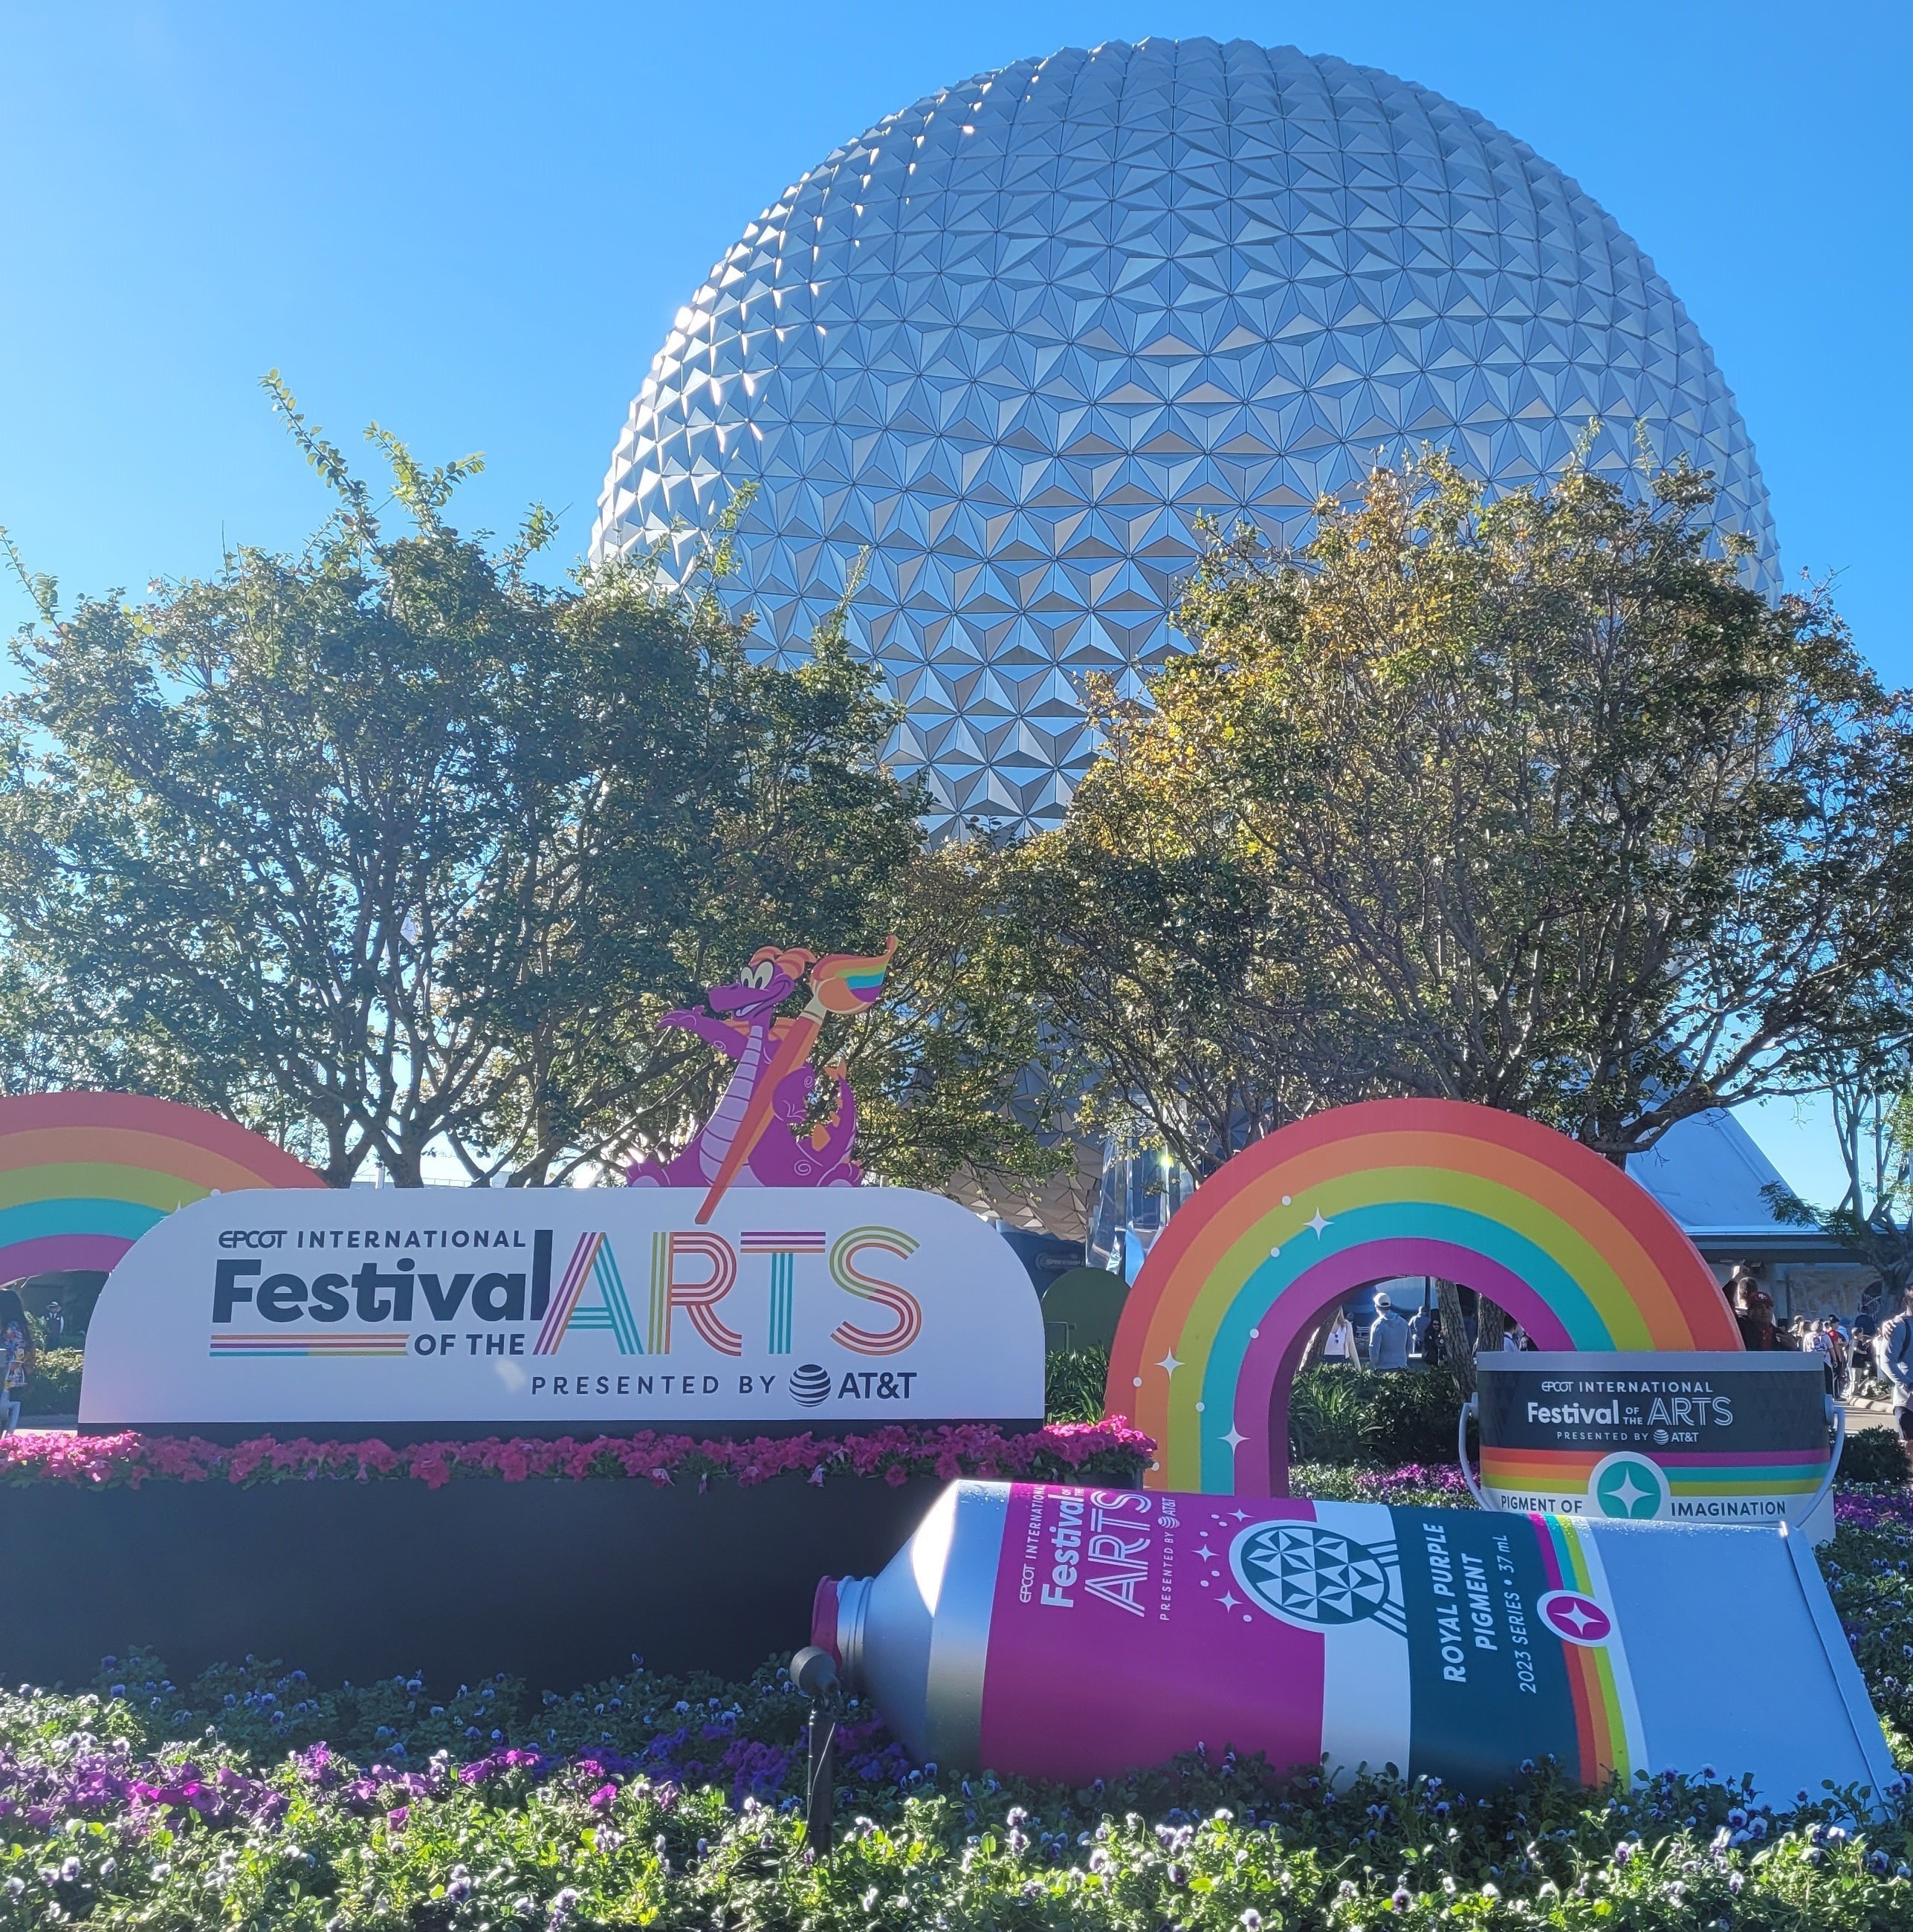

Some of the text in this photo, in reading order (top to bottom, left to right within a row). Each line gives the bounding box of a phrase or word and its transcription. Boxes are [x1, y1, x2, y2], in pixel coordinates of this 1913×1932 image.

[218, 1230, 526, 1248] EPCOT INTERNATIONAL
[212, 1230, 553, 1323] Festival
[532, 1225, 922, 1357] ARTS
[414, 1333, 525, 1356] OF THE
[531, 1372, 918, 1399] PRESENTED BY AT&T
[1541, 1381, 1713, 1393] EPCOT INTERNATIONAL
[1527, 1396, 1733, 1427] Festival OF THE ARTS
[1557, 1431, 1700, 1443] PRESENTED BY AT&T
[1501, 1495, 1785, 1517] PIGMENT OF IMAGINATION
[1040, 1494, 1084, 1608] Festival
[1084, 1491, 1151, 1618] ARTS
[1159, 1497, 1176, 1621] PRESENTED BY AT&T
[1020, 1563, 1035, 1603] EPCOT
[1422, 1523, 1466, 1682] ROYAL PURPLE
[1461, 1553, 1498, 1651] PIGMENT
[1492, 1534, 1537, 1694] 2023 SERIES 37 mL
